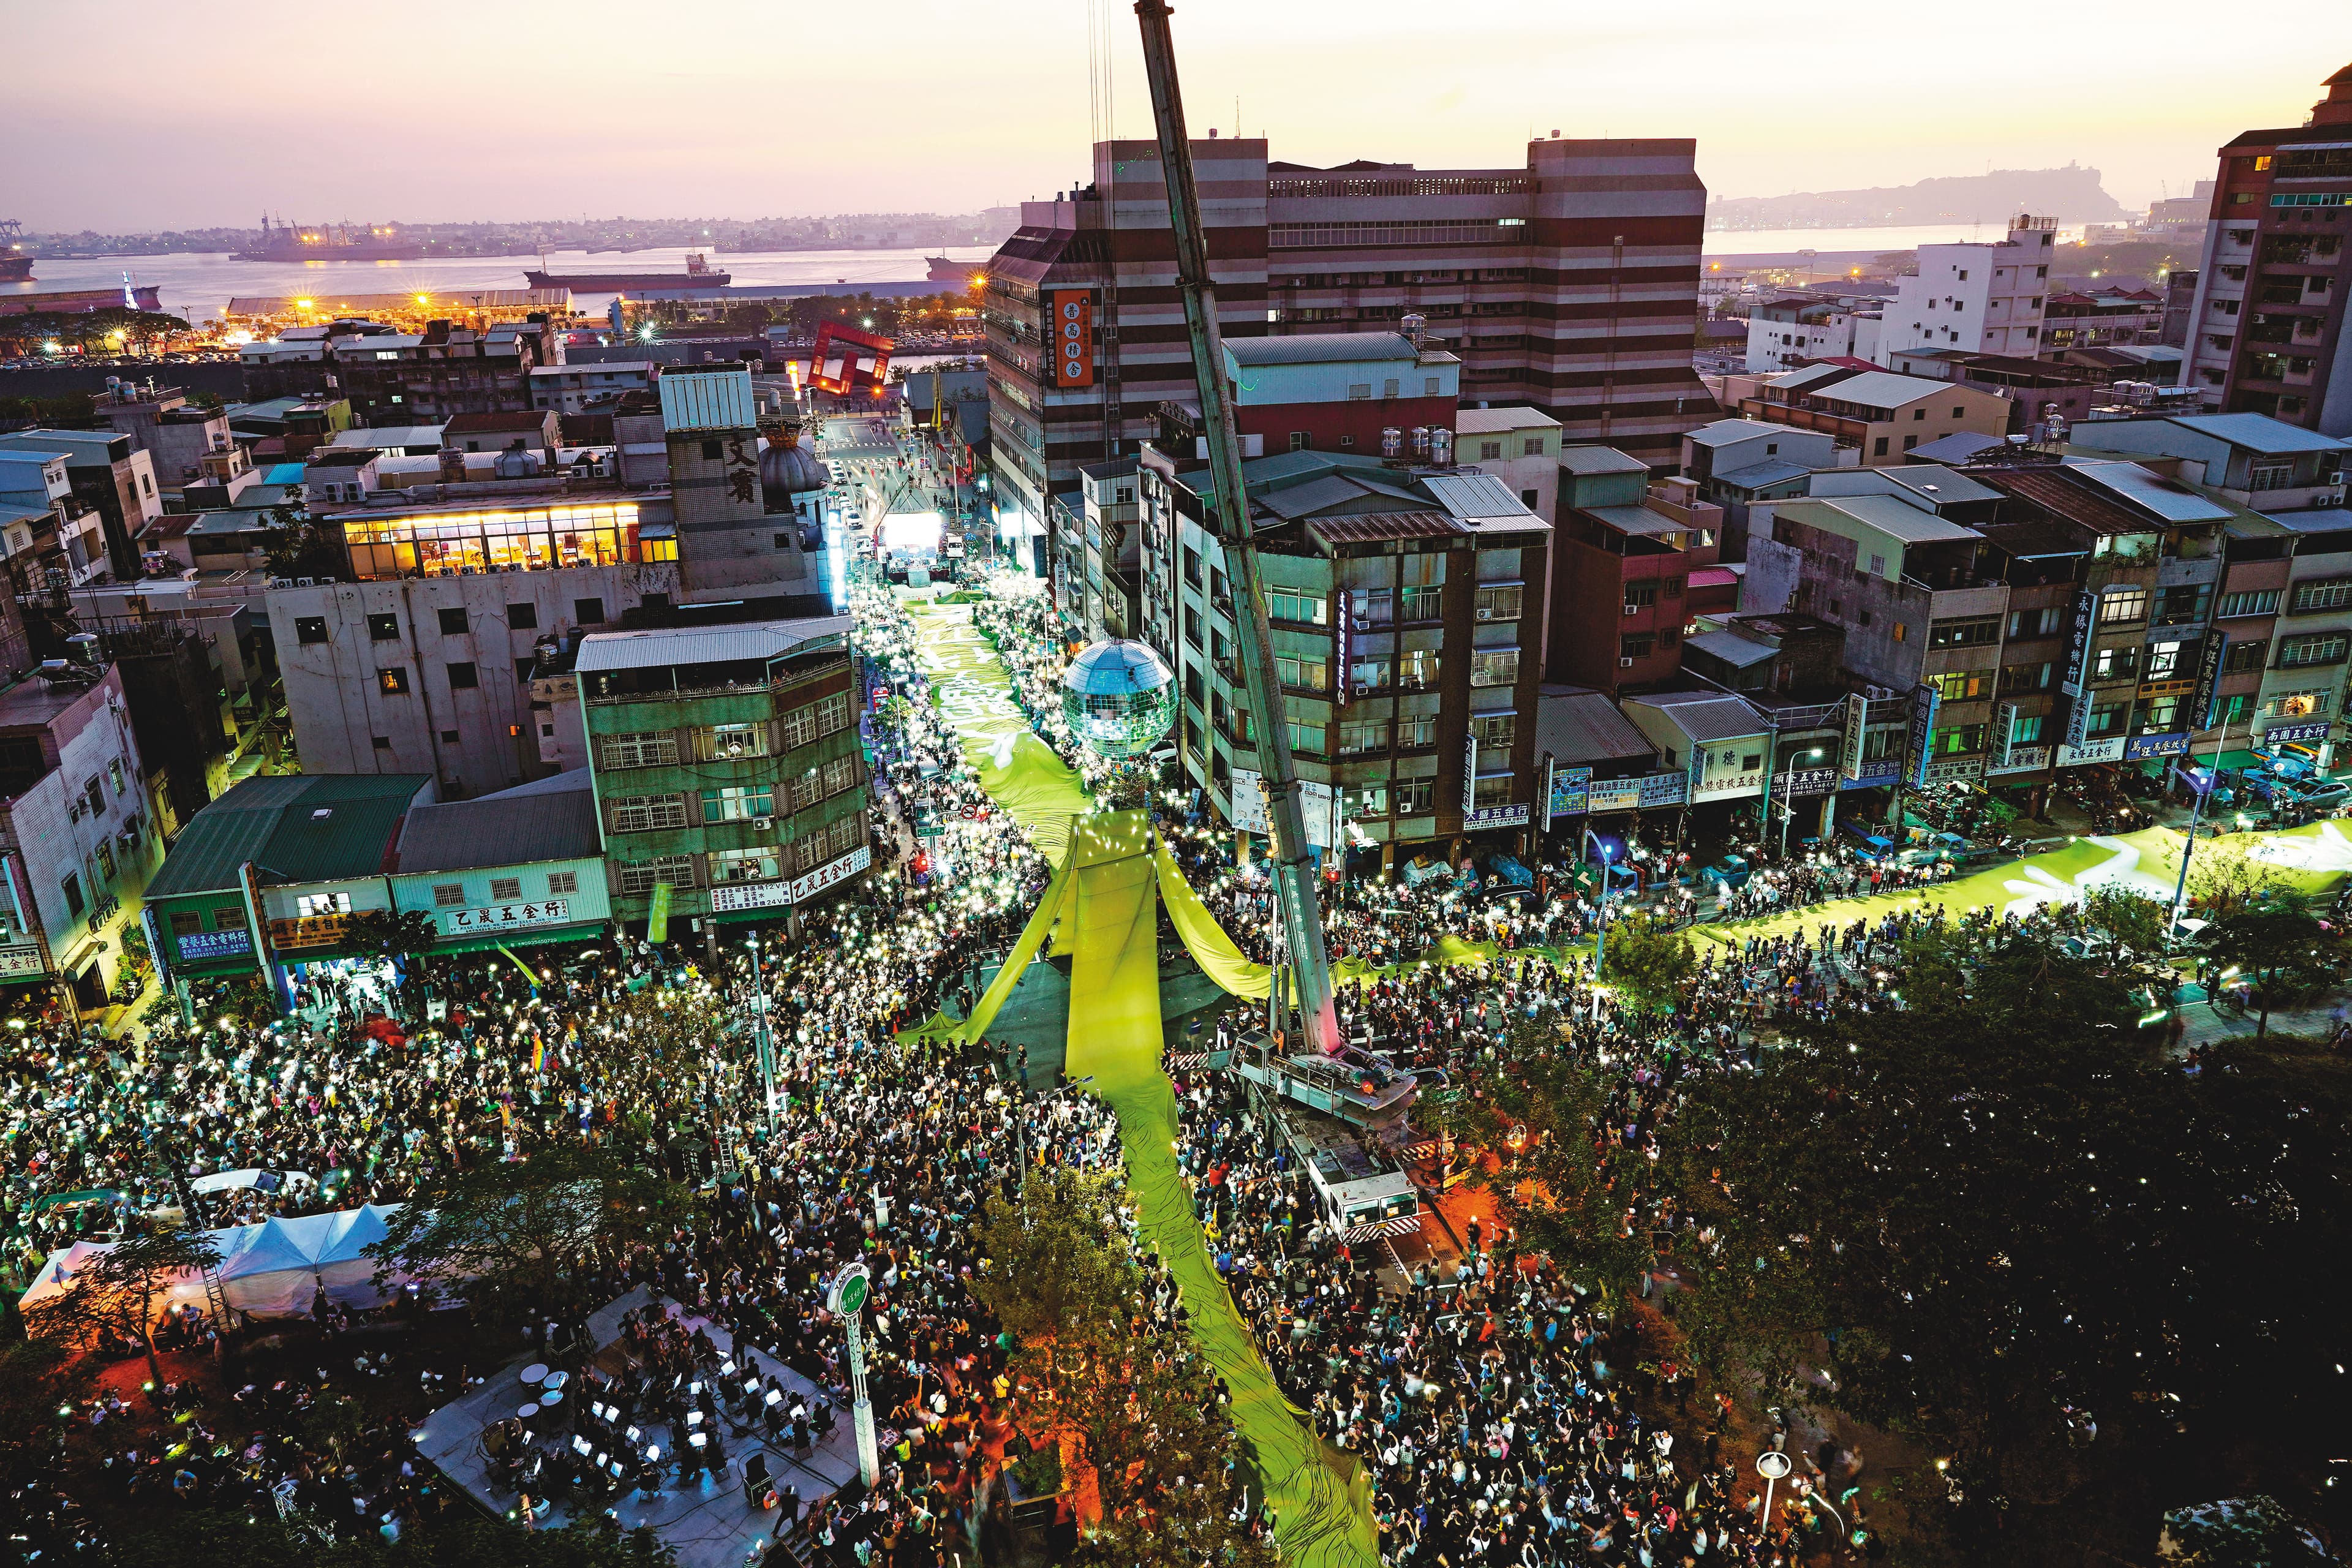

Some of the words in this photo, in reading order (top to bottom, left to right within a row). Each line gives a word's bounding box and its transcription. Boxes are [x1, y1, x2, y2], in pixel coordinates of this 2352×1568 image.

[1066, 304, 1080, 375] 普高精舍
[2067, 597, 2089, 682] 永勝電機行
[1844, 698, 1861, 767] 順隆五金行
[1912, 689, 1929, 751] 國凌五金
[2071, 701, 2087, 743] 永隆五金行
[2069, 745, 2112, 760] 永隆五金行
[1232, 777, 1246, 785] SMC
[1466, 805, 1528, 821] 大盛五金行
[794, 858, 853, 899] 乙晟五金行
[455, 900, 560, 926] 乙晟五金行
[834, 1265, 863, 1291] YAN-CHEN
